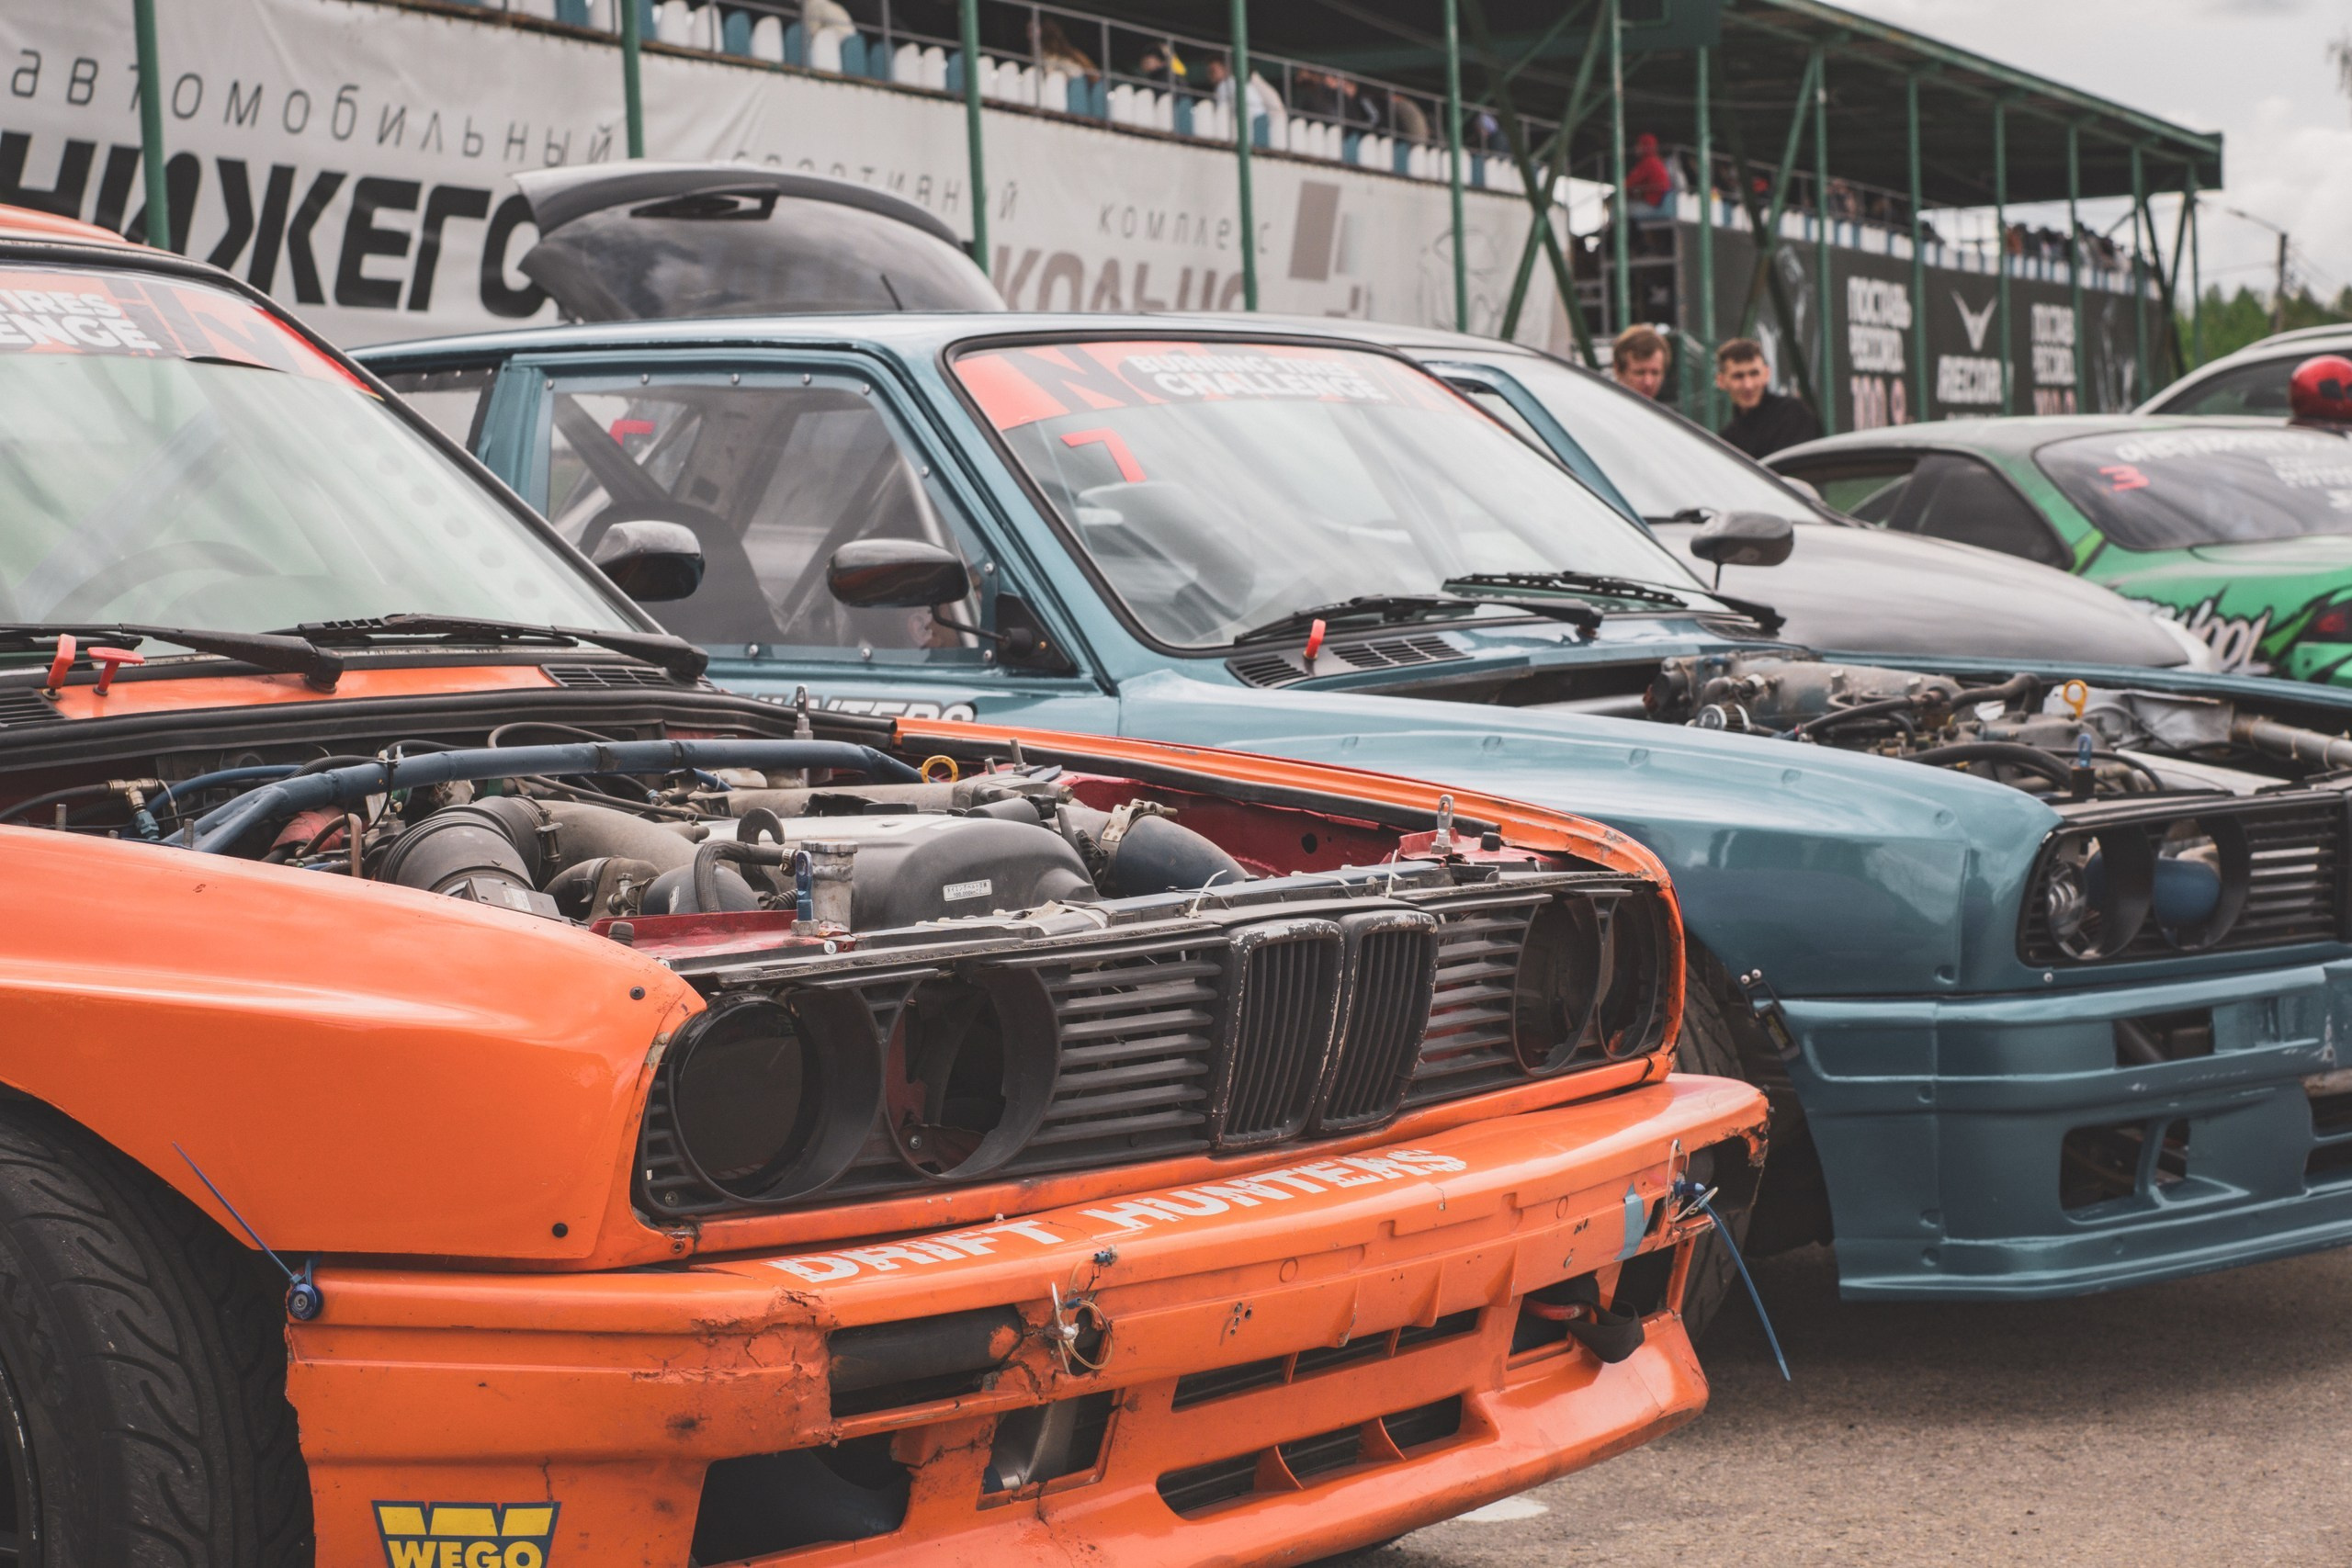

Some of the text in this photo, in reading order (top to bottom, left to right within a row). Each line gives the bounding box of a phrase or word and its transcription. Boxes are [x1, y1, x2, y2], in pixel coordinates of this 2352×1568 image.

[1153, 372, 1390, 401] CHALLENGE
[763, 1150, 1467, 1283] DRIFT HUNTERS
[387, 1540, 542, 1568] WEGO
